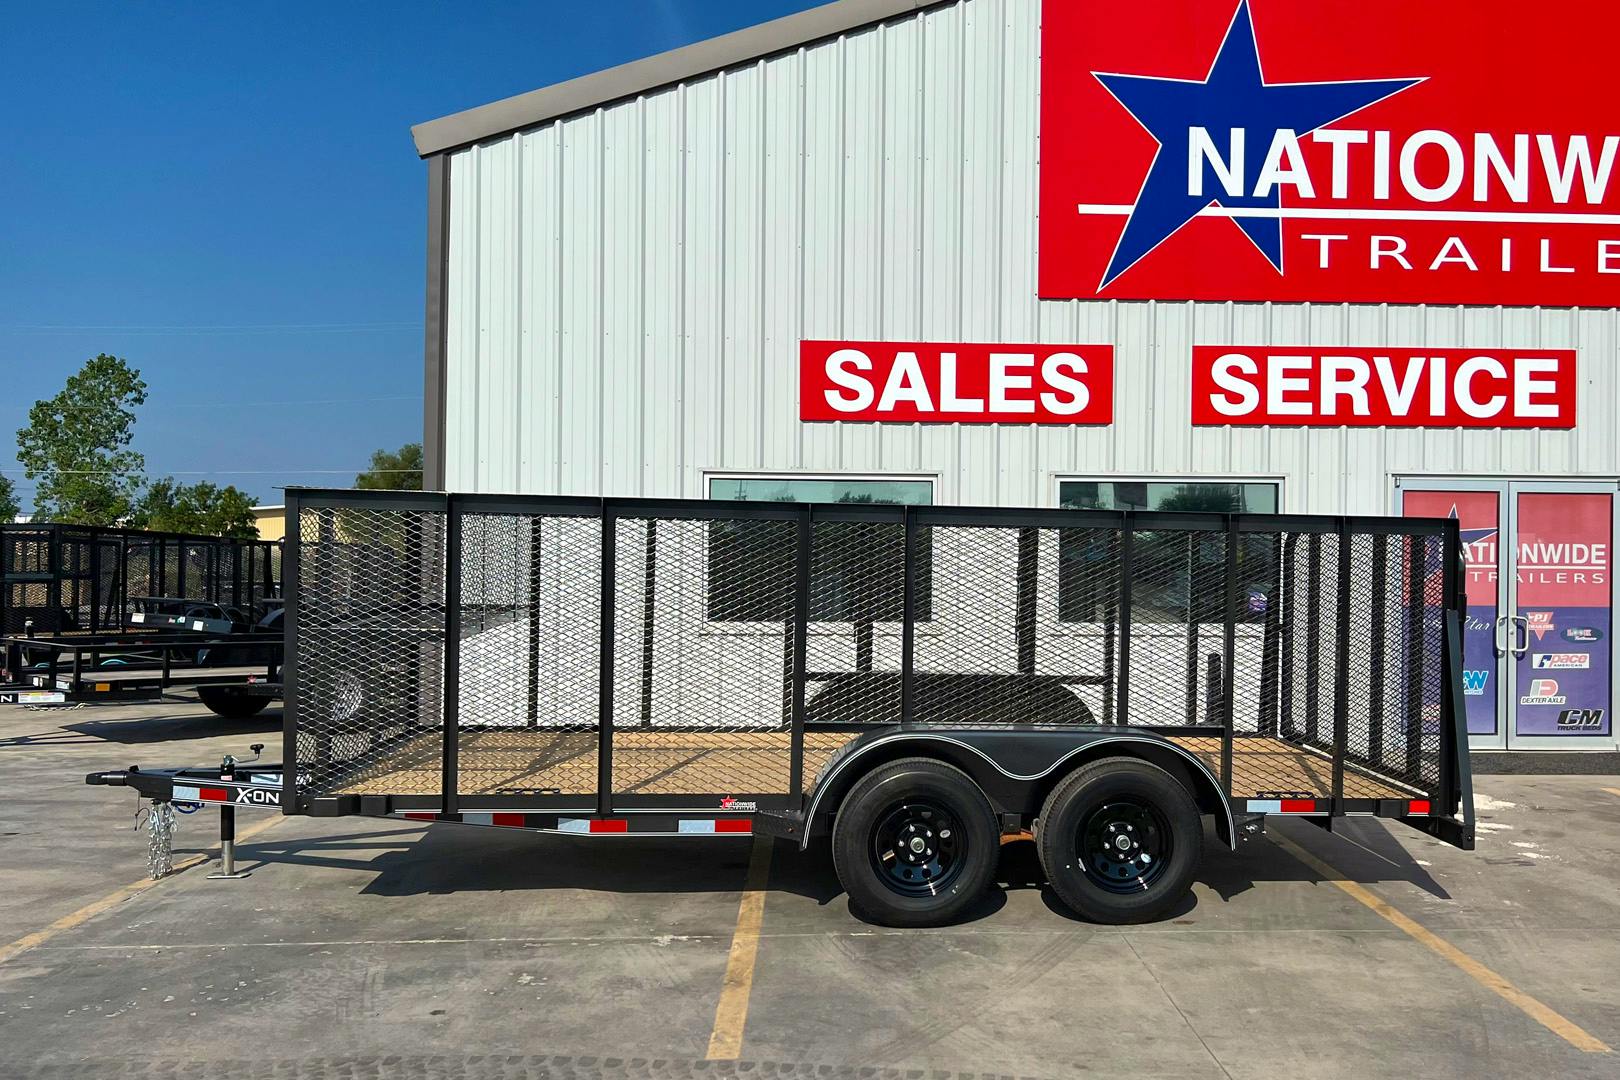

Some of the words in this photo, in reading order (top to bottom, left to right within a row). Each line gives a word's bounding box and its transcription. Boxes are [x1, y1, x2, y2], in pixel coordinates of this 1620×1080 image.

[1187, 126, 1620, 205] NATIONW
[824, 348, 1090, 415] SALES
[1209, 354, 1559, 419] SERVICE
[1557, 709, 1604, 725] CM
[236, 787, 280, 805] X-ON
